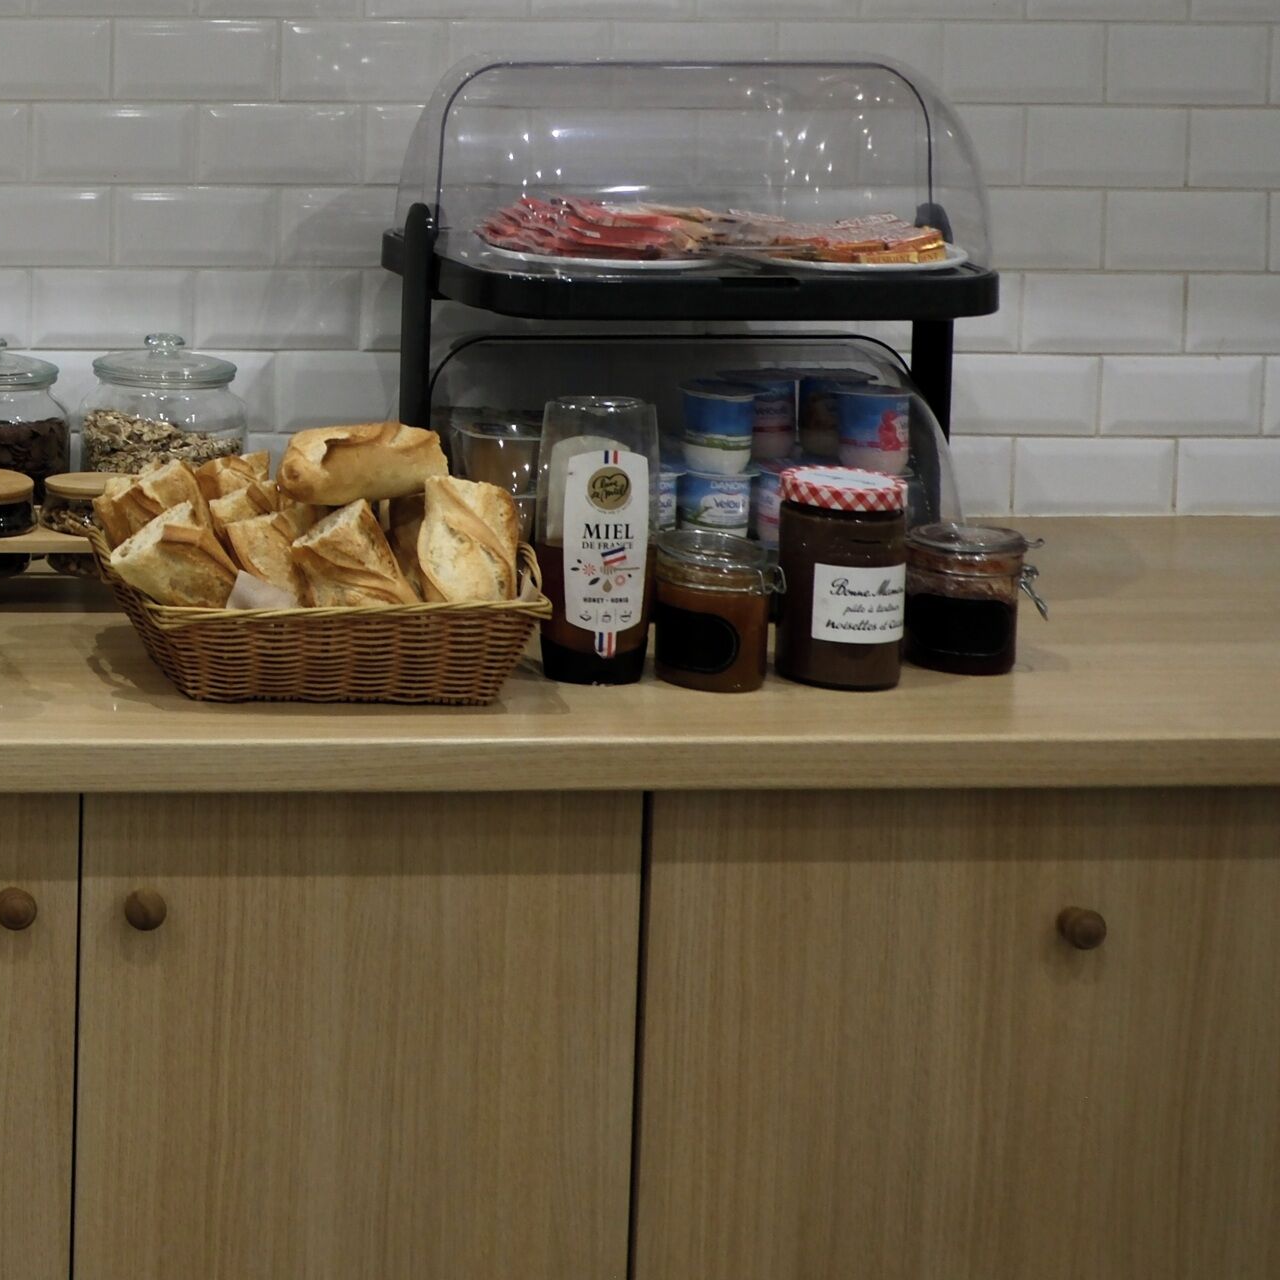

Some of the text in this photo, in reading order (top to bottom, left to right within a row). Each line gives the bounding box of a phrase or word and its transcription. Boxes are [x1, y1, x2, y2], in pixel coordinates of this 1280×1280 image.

[582, 523, 634, 540] MIEL
[581, 541, 633, 550] DE FRANCE
[830, 577, 904, 597] Bonne Mama
